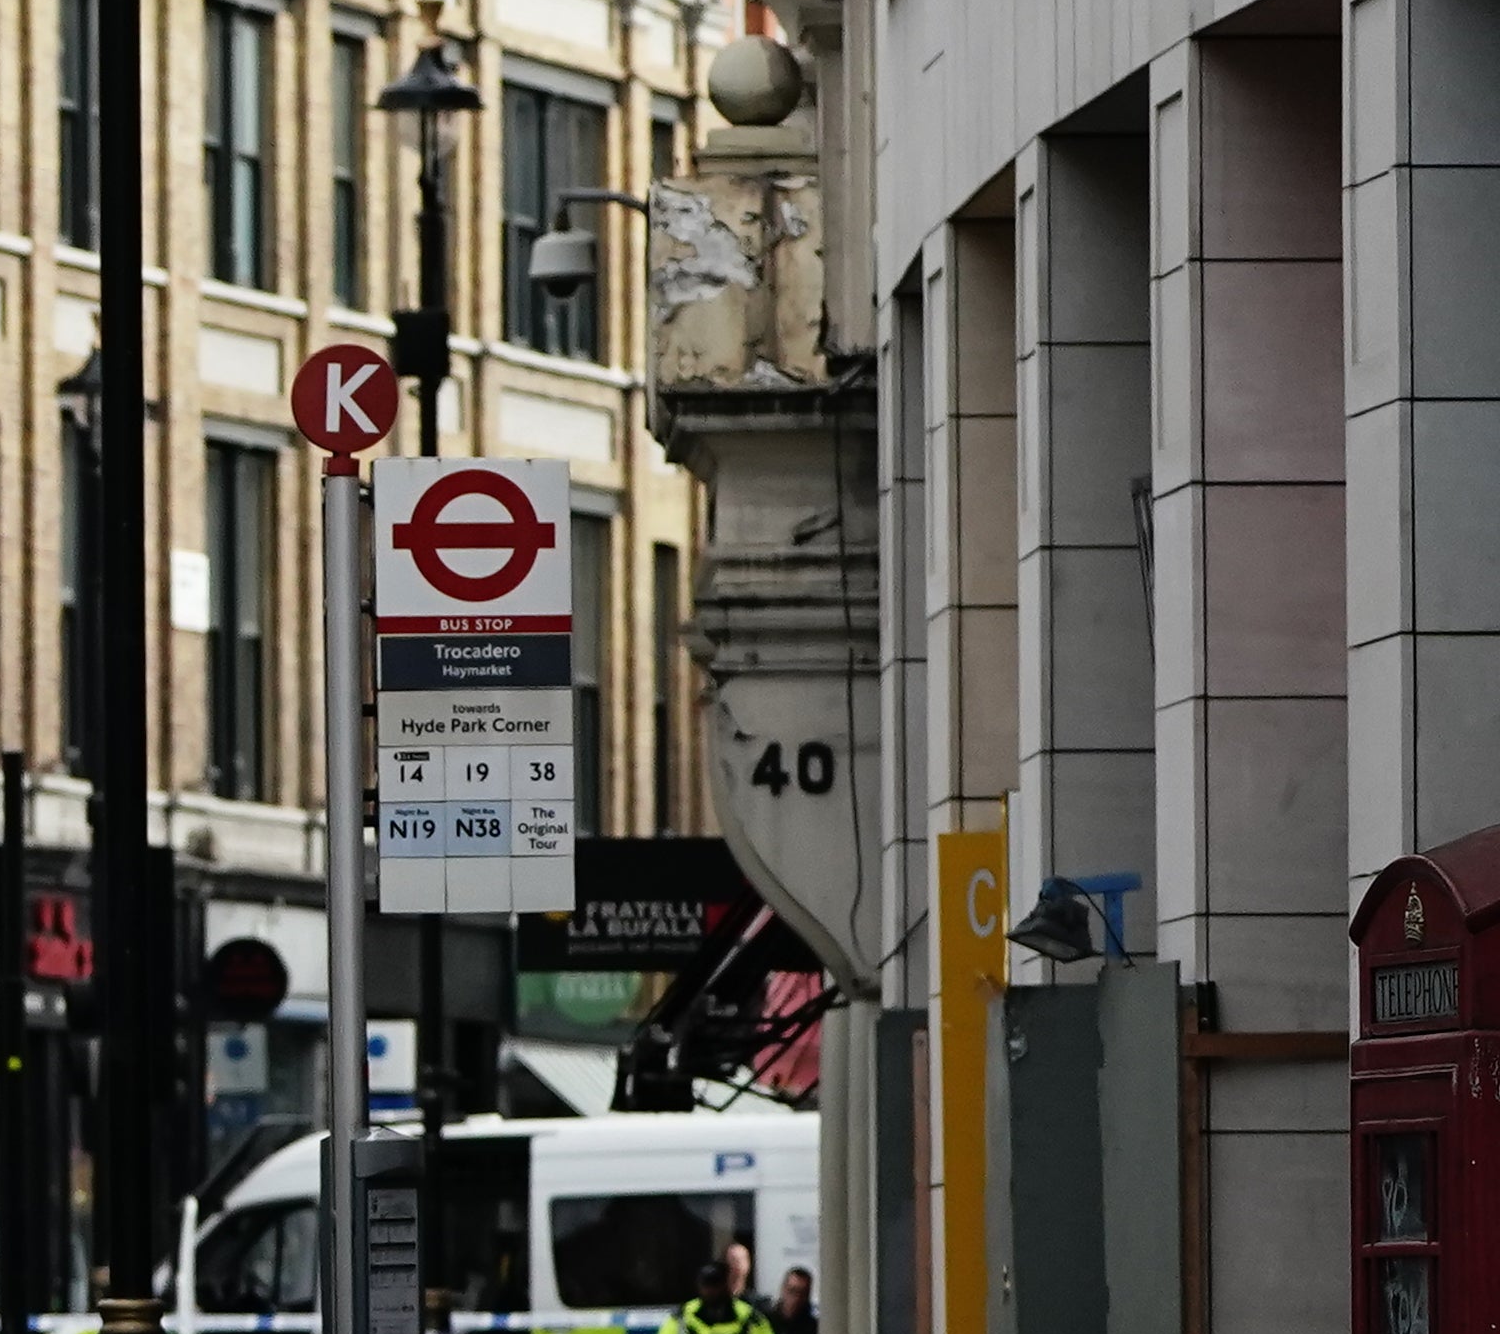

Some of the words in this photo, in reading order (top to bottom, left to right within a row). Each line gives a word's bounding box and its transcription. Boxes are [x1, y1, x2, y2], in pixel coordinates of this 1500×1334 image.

[324, 363, 380, 435] K
[440, 618, 469, 632] BUS
[475, 618, 513, 631] STOP
[434, 642, 521, 660] Trocadero
[442, 664, 512, 679] Haymarket
[452, 703, 501, 715] towards
[401, 718, 446, 737] Hyde
[451, 718, 487, 733] Park
[492, 717, 551, 734] Corner
[399, 764, 424, 783] 14
[466, 762, 490, 782] 19
[530, 761, 556, 781] 38
[751, 740, 835, 800] 40
[531, 806, 555, 819] The
[390, 819, 436, 839] N19
[456, 818, 502, 838] N38
[517, 821, 569, 837] Original
[529, 837, 558, 851] Tour
[586, 900, 704, 919] FRATELLI
[1378, 966, 1460, 1019] TELEPHONE
